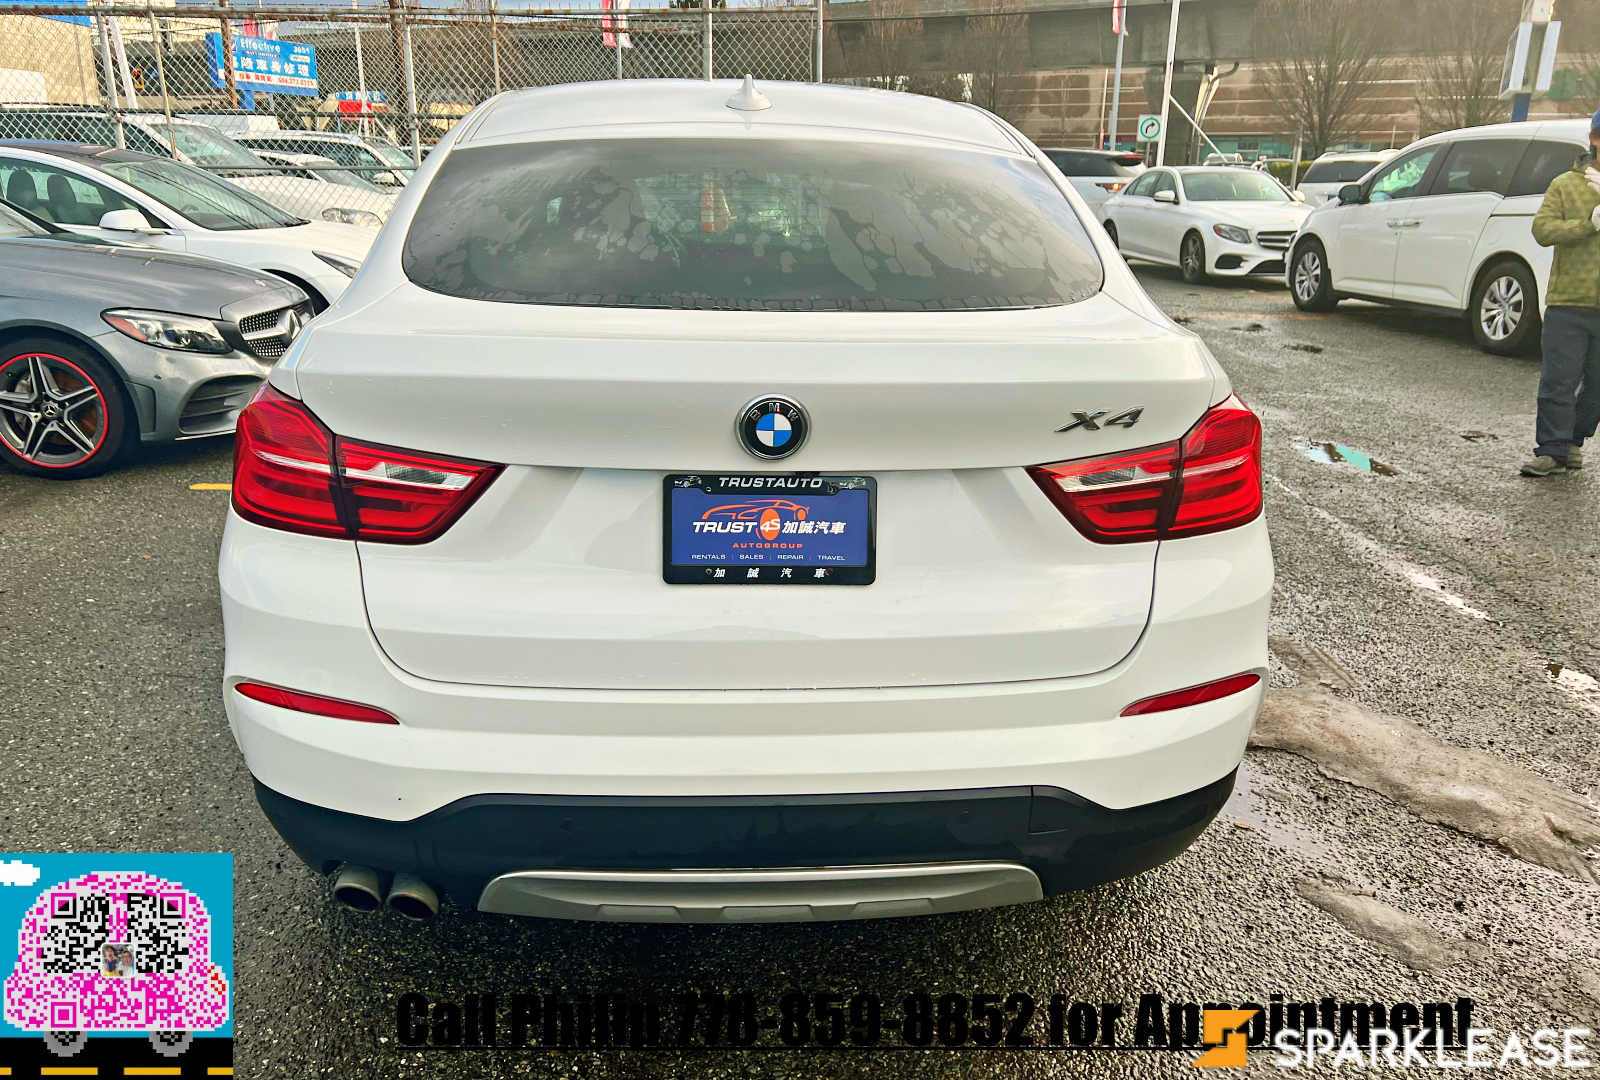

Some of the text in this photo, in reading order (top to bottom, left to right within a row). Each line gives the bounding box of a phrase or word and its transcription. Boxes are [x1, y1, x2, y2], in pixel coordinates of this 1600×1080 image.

[240, 38, 280, 53] Effective
[1054, 407, 1144, 432] X4
[718, 477, 822, 488] TRUSTAUTO
[692, 521, 757, 534] TRUST
